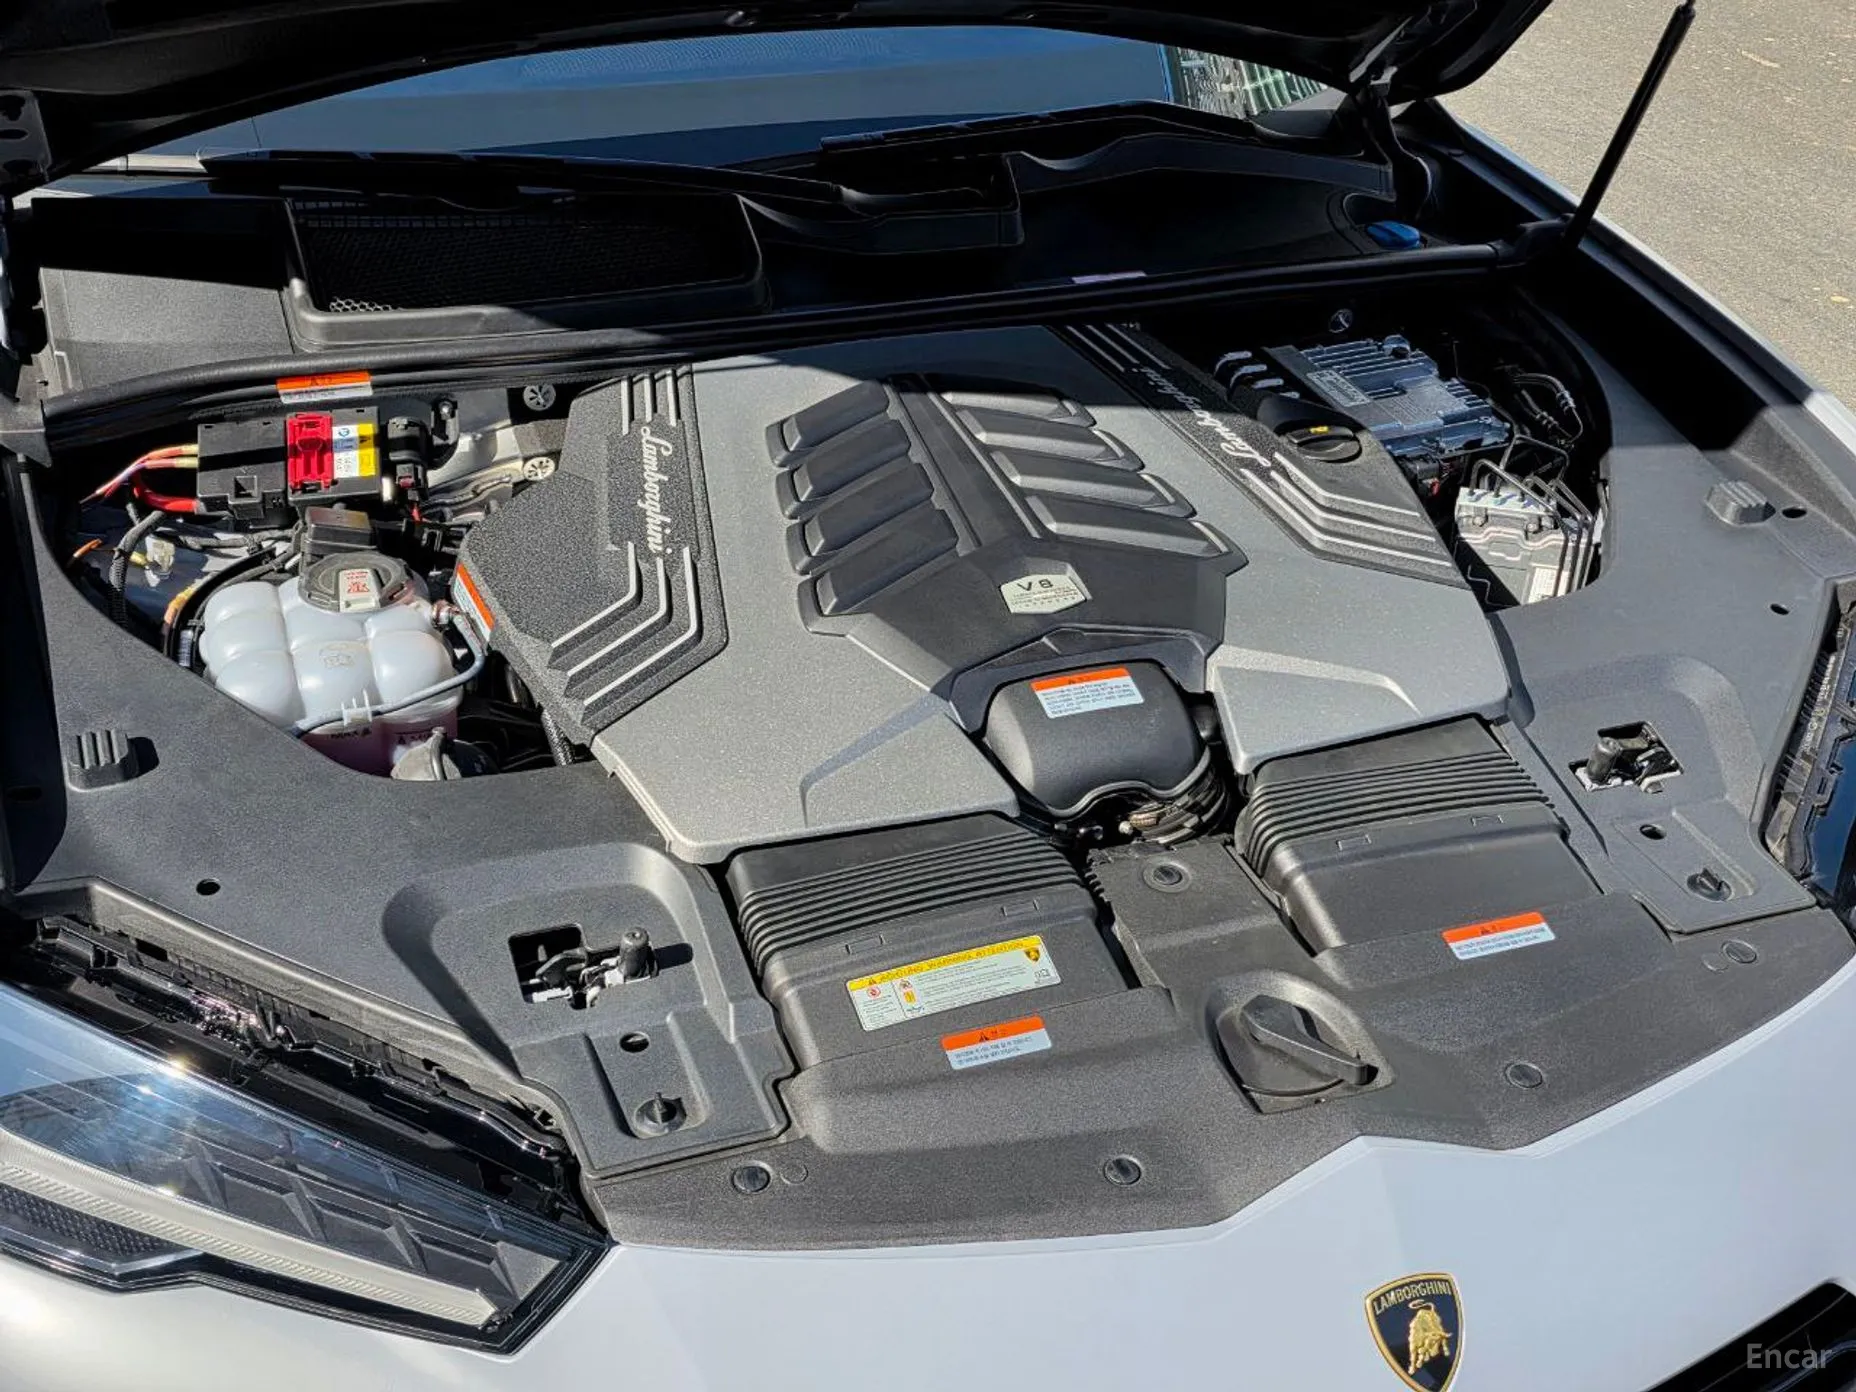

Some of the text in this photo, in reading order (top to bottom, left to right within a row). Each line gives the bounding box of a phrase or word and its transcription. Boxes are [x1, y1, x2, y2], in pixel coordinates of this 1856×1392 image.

[1131, 367, 1272, 467] Lamborghini
[637, 426, 673, 554] Lamborghini
[1016, 578, 1054, 592] V8
[1373, 1280, 1452, 1315] LAMBORGHINI
